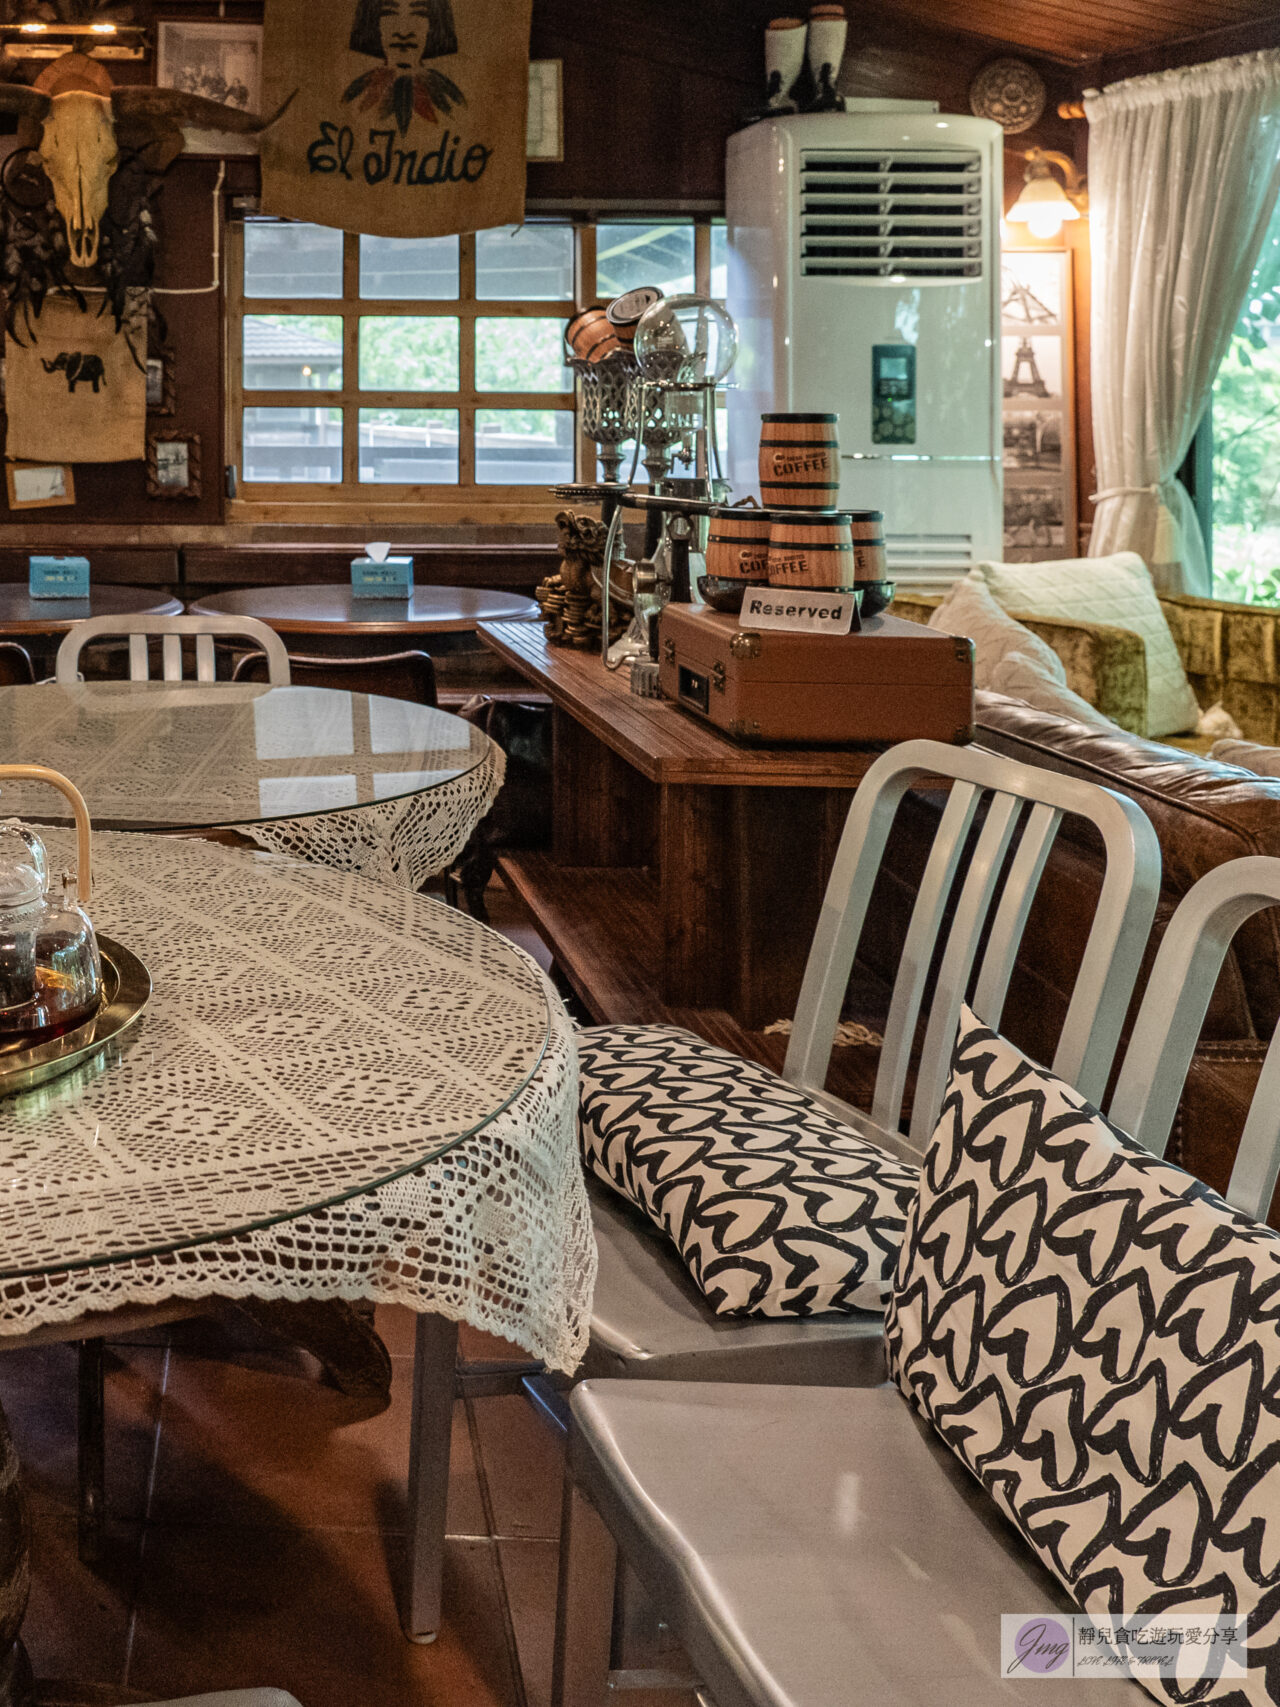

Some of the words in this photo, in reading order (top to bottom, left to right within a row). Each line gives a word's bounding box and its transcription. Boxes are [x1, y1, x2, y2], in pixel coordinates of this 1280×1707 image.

[307, 121, 353, 181] El
[363, 129, 495, 186] Indio
[773, 457, 829, 477] COFFEE
[749, 598, 843, 621] Reserved
